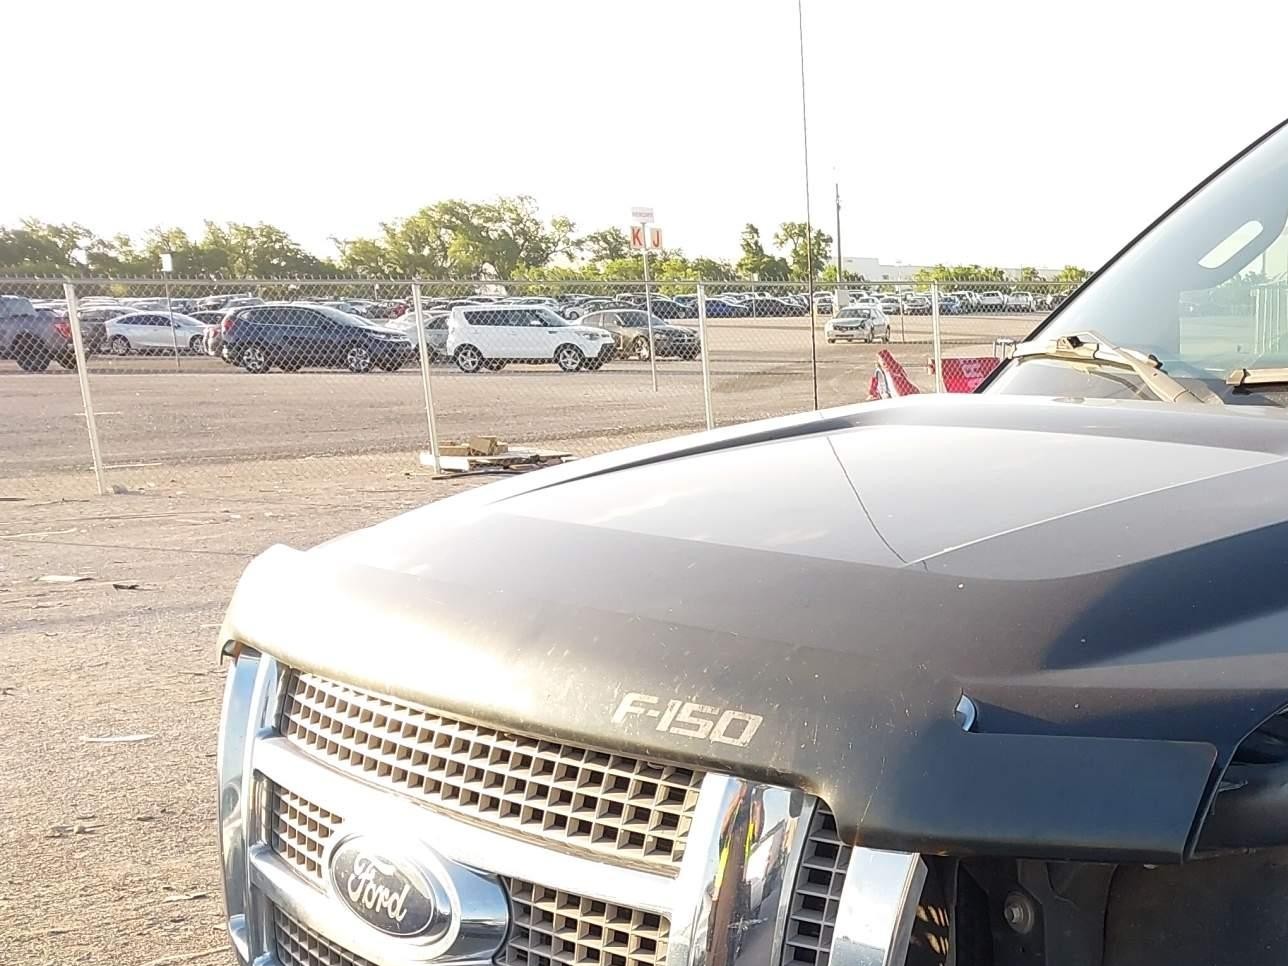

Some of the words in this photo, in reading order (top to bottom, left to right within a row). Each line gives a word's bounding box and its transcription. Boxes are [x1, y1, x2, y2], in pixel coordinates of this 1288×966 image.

[631, 227, 643, 247] K
[652, 229, 660, 248] J
[611, 692, 764, 748] F-150
[347, 851, 411, 922] Ford
